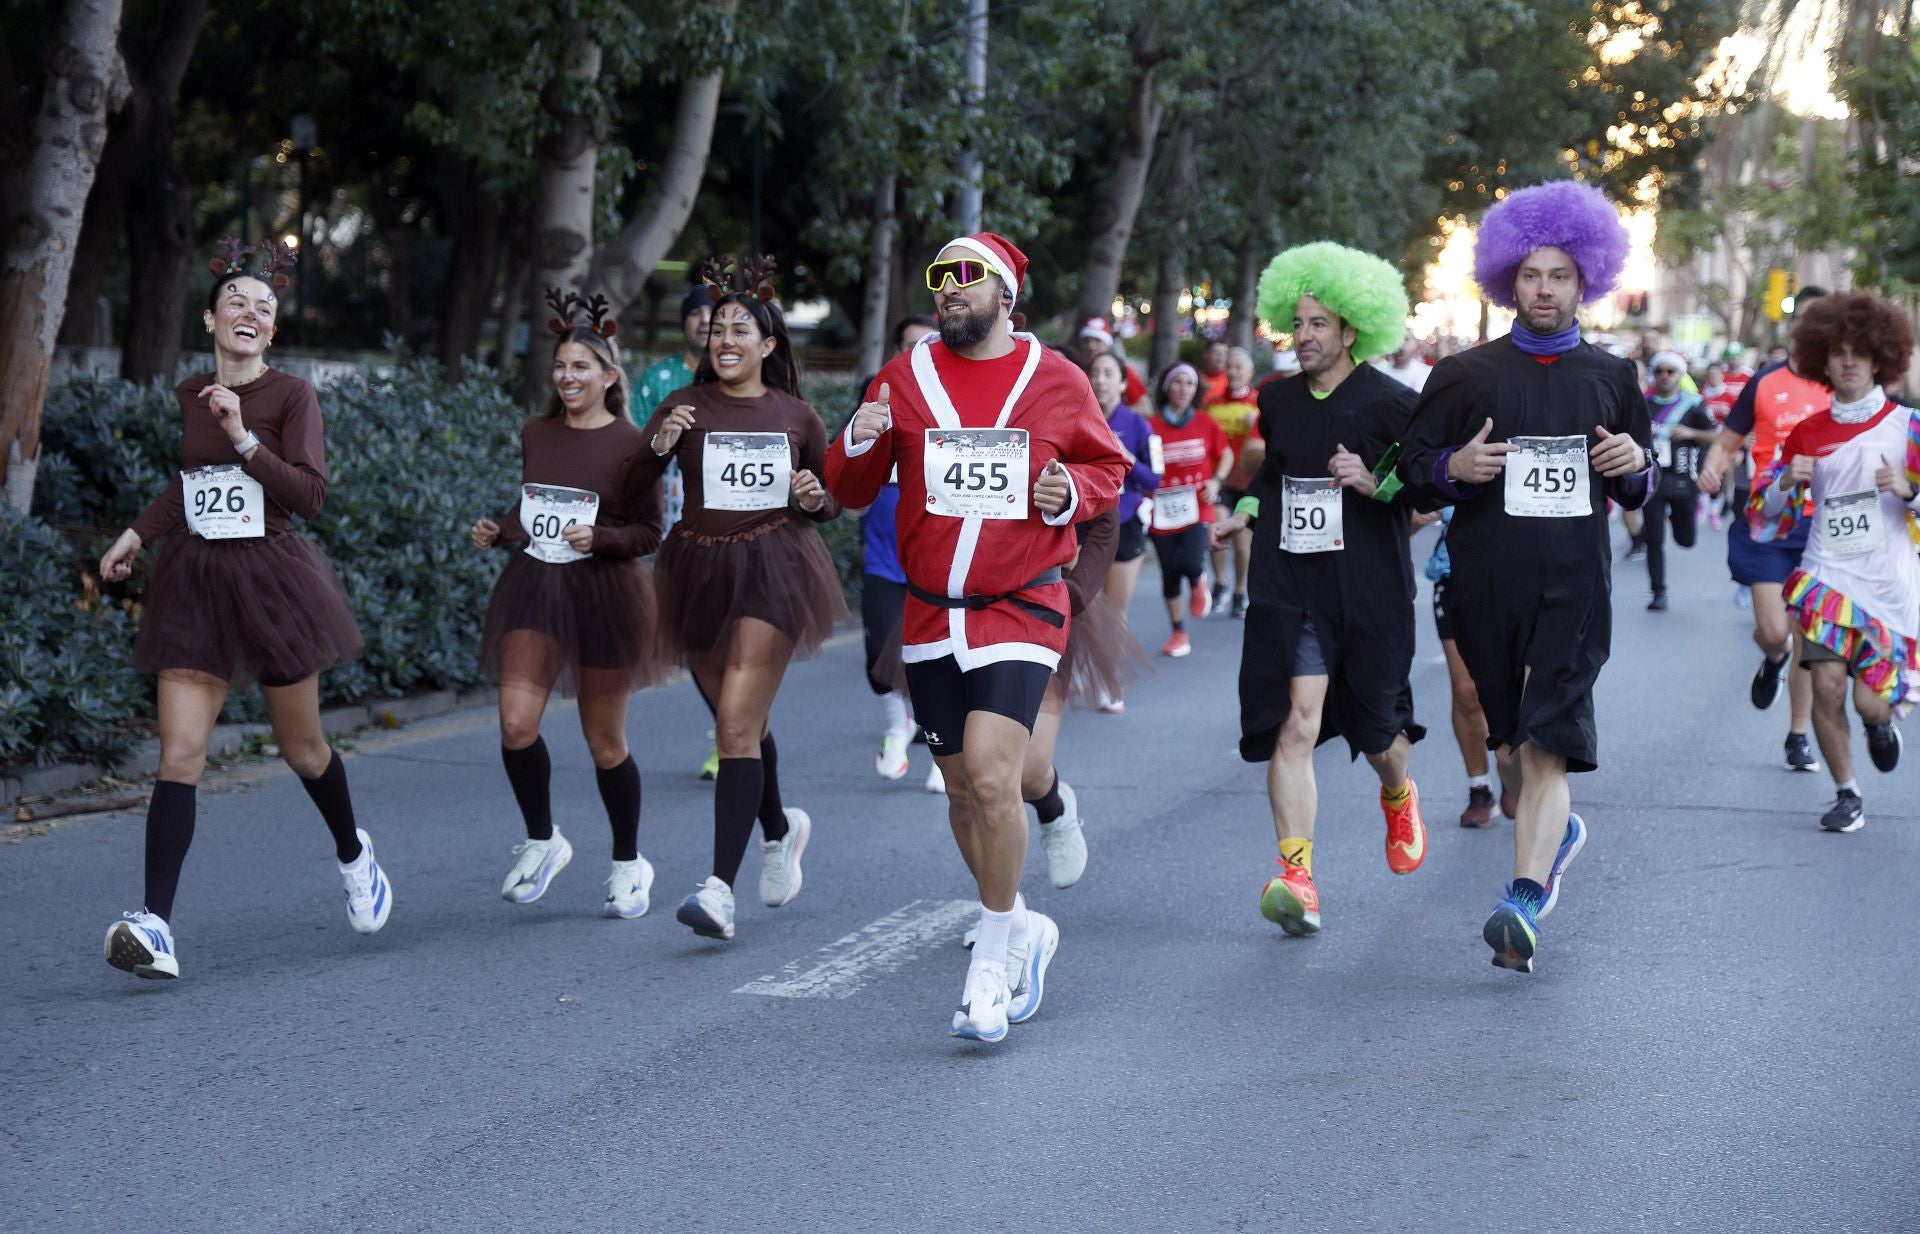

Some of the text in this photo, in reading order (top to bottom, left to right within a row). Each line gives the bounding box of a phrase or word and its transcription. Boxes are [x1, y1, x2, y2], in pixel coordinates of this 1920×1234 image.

[721, 463, 775, 487] 465
[944, 463, 1008, 491] 455
[1523, 467, 1576, 493] 459
[195, 485, 245, 517] 926
[1828, 514, 1870, 537] 594
